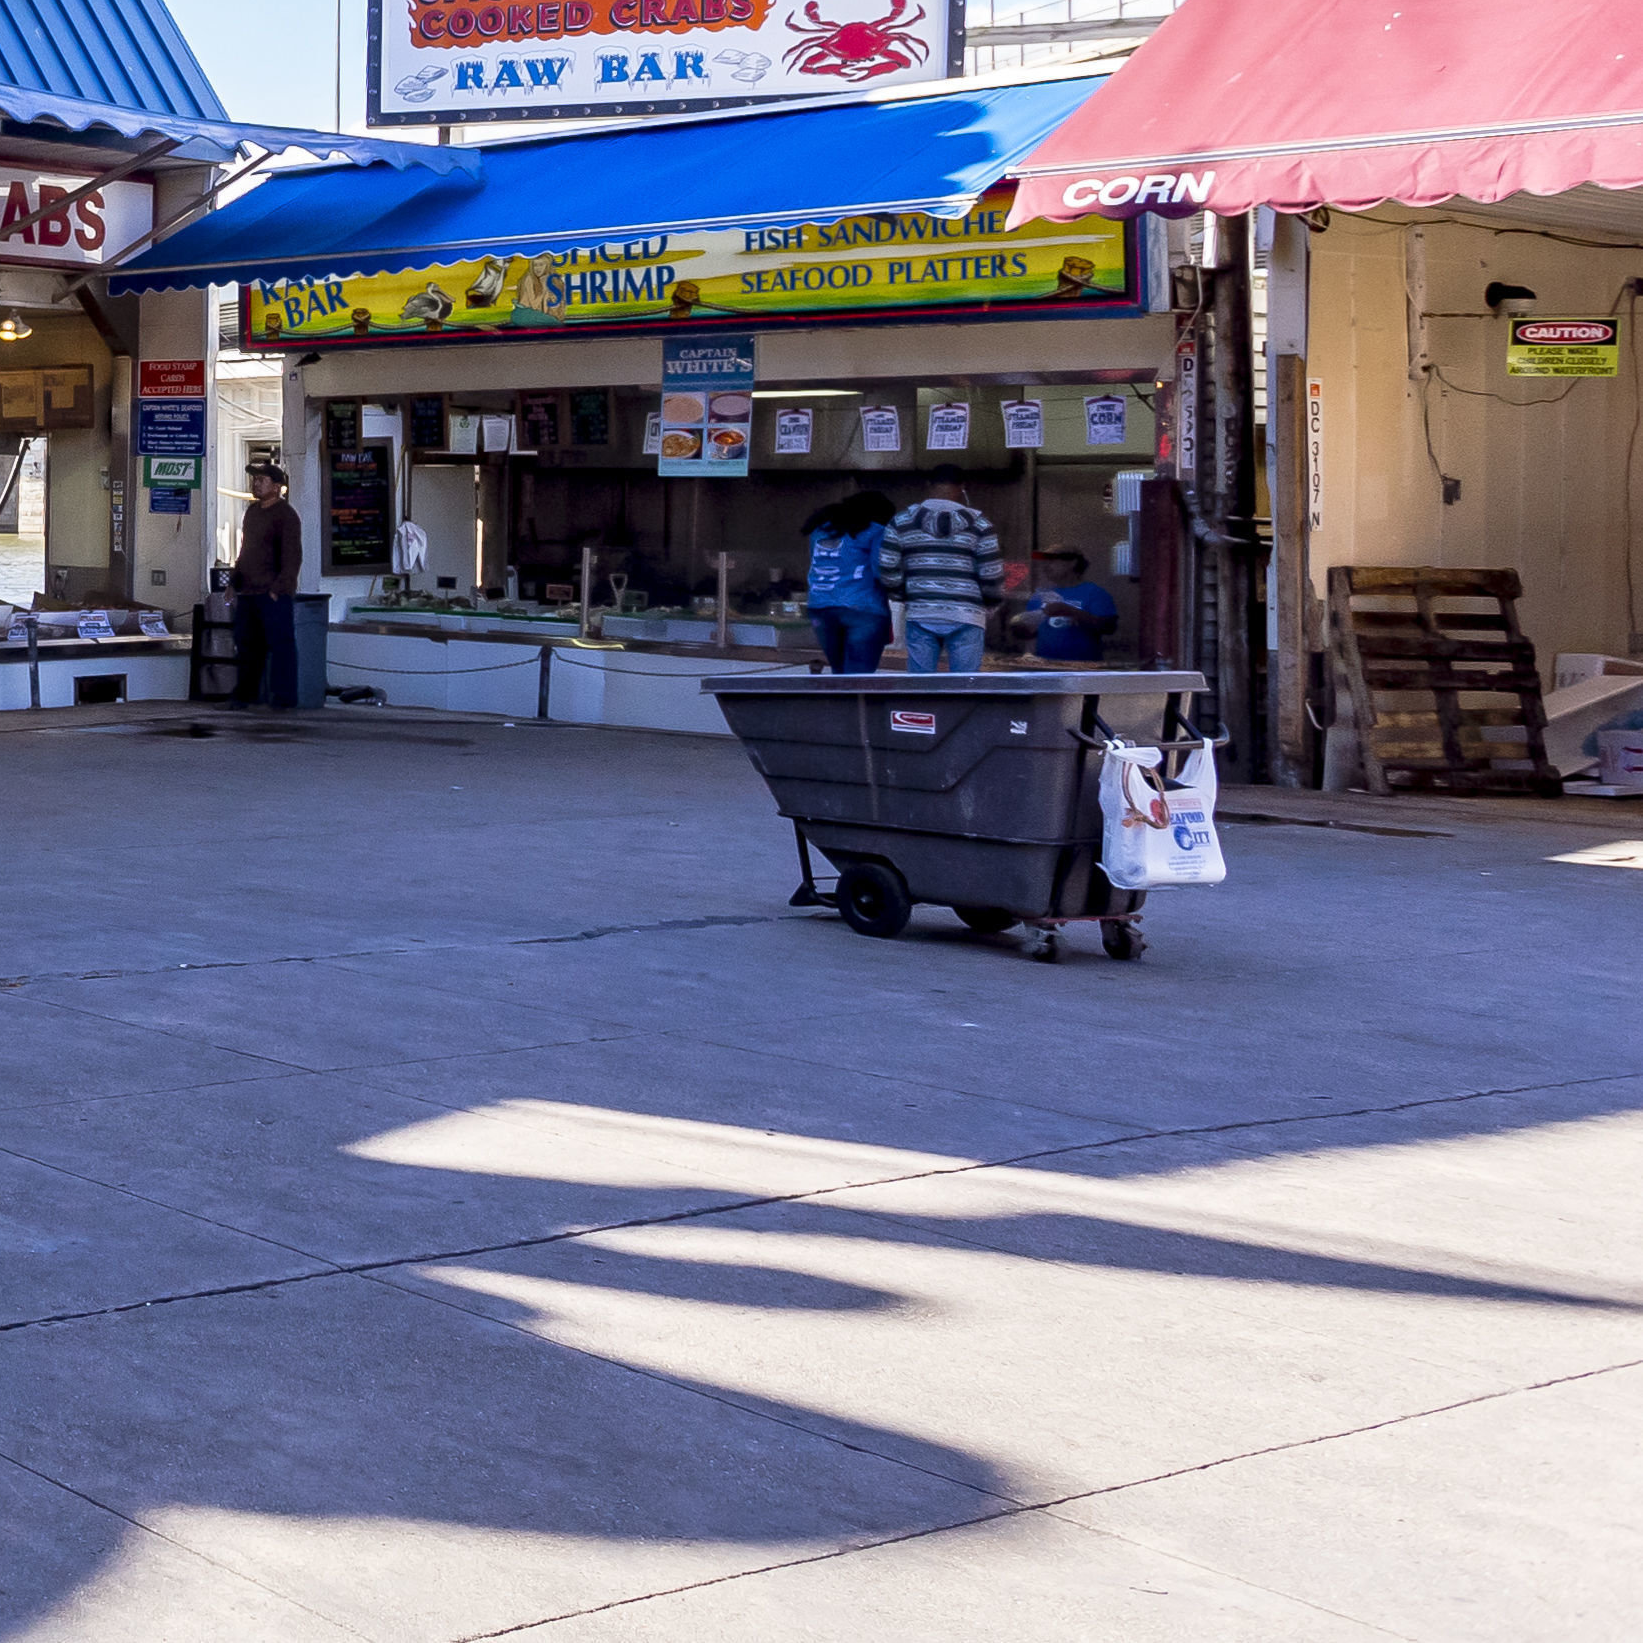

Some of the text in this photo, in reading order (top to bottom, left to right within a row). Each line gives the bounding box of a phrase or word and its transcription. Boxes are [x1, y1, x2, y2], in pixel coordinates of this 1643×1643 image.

[420, 1, 594, 40] COOKED
[453, 50, 710, 91] RAW BAR
[1063, 171, 1216, 209] CORN
[744, 229, 804, 252] FISH
[740, 253, 1028, 295] SEAFOOD PLATTERS
[545, 264, 676, 308] SHRIMP
[283, 280, 350, 329] BAR
[1525, 327, 1604, 338] CAUTION
[679, 348, 738, 360] CAPTAIN
[666, 358, 754, 375] WHITE'S
[1090, 412, 1122, 426] CORN
[154, 461, 191, 476] MOST
[1169, 812, 1205, 825] EAFOOD
